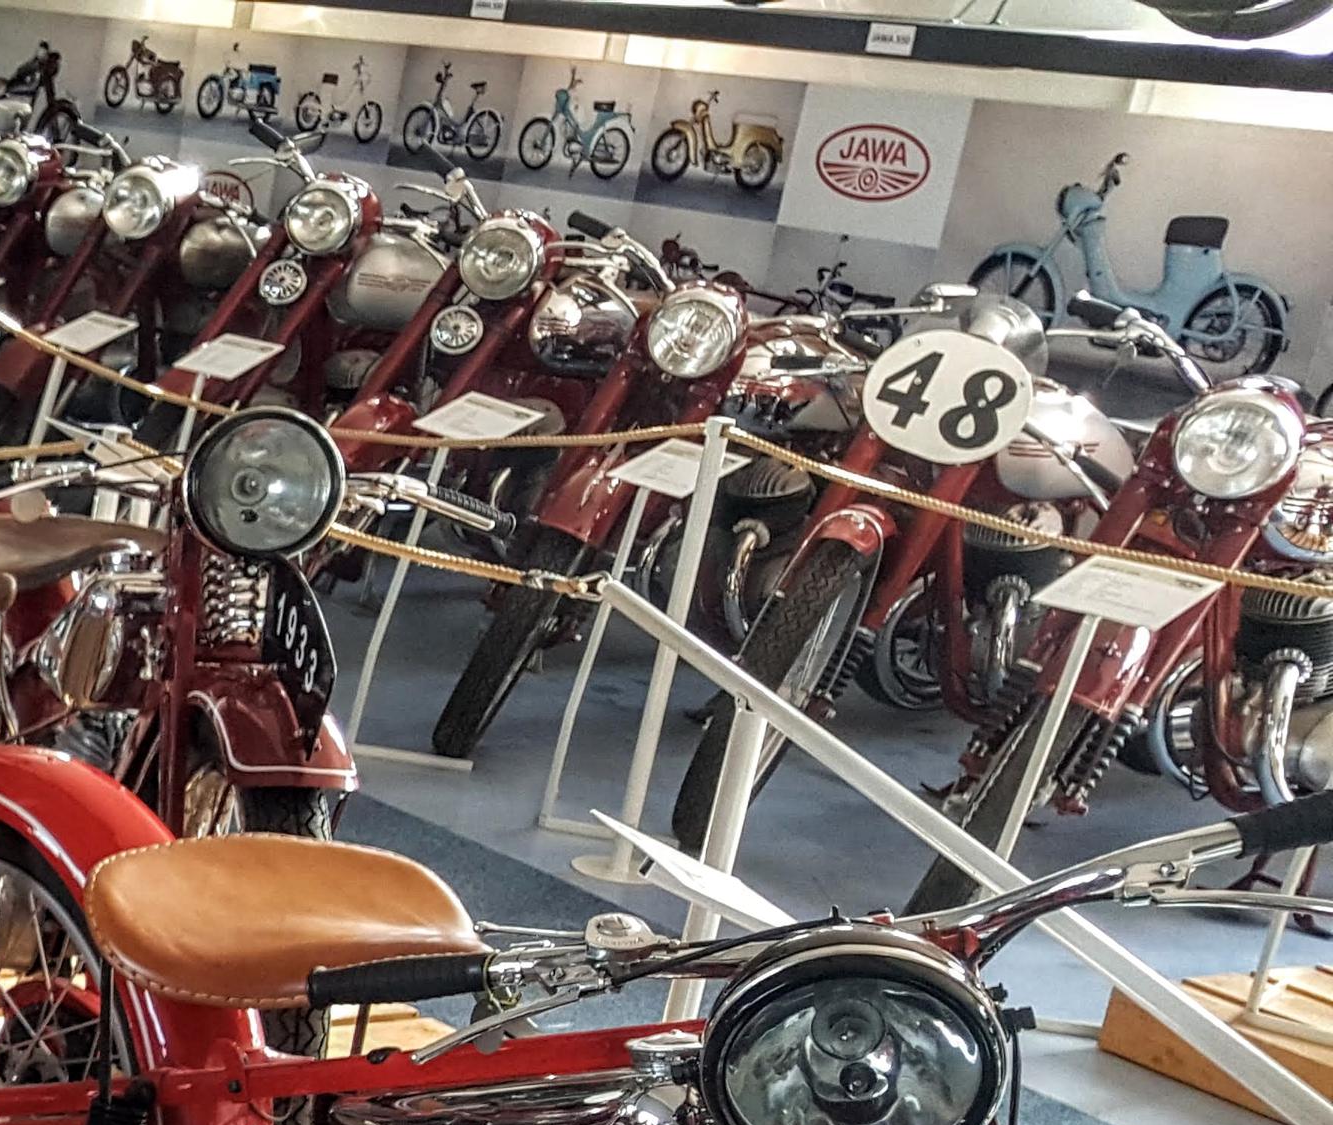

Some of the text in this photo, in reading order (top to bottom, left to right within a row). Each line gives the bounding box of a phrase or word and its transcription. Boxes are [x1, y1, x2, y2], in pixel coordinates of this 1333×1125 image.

[839, 136, 908, 168] JAWA
[876, 351, 1018, 449] 48
[275, 592, 318, 694] 1933
